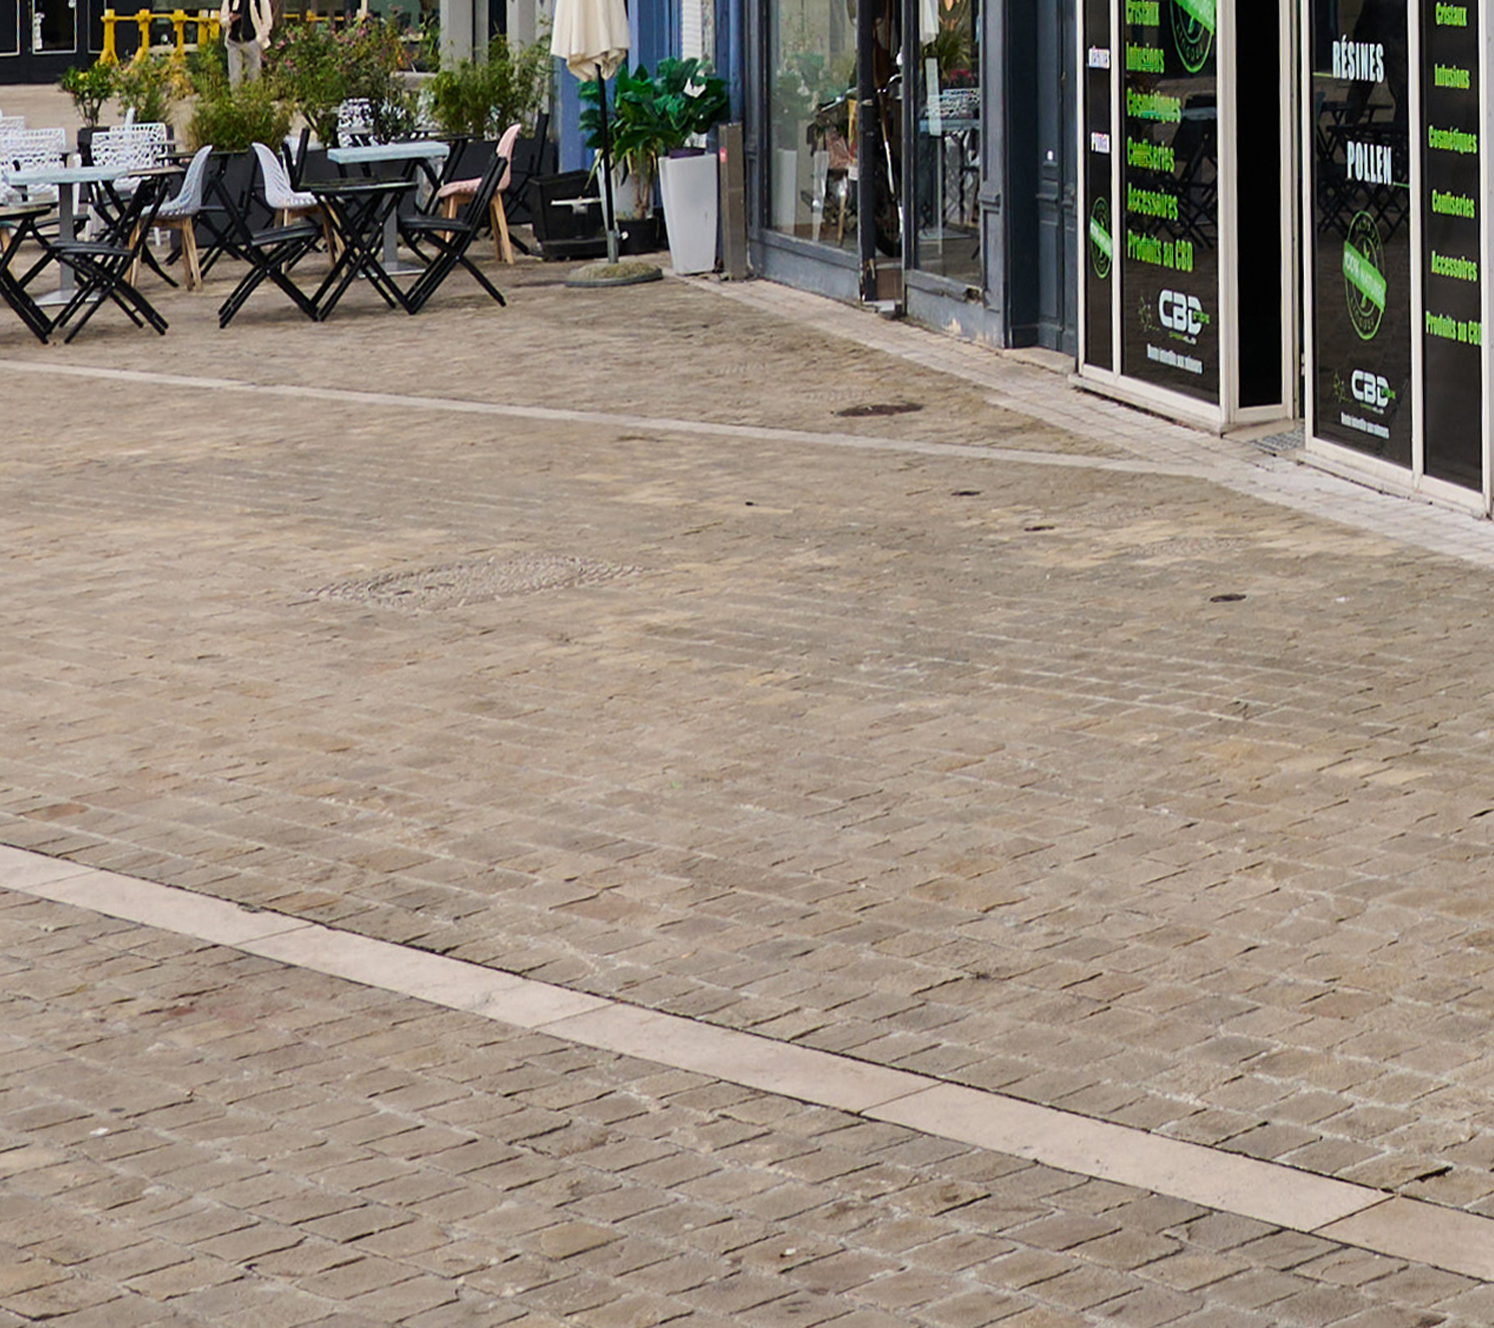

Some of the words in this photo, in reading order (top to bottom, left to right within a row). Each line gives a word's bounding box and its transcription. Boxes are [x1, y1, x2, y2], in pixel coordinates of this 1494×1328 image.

[1332, 34, 1385, 83] RÉSINES
[1346, 140, 1392, 185] POLLEN
[1431, 250, 1477, 282] Accessoires
[1159, 289, 1203, 336] CBD
[1351, 369, 1390, 407] CBD
